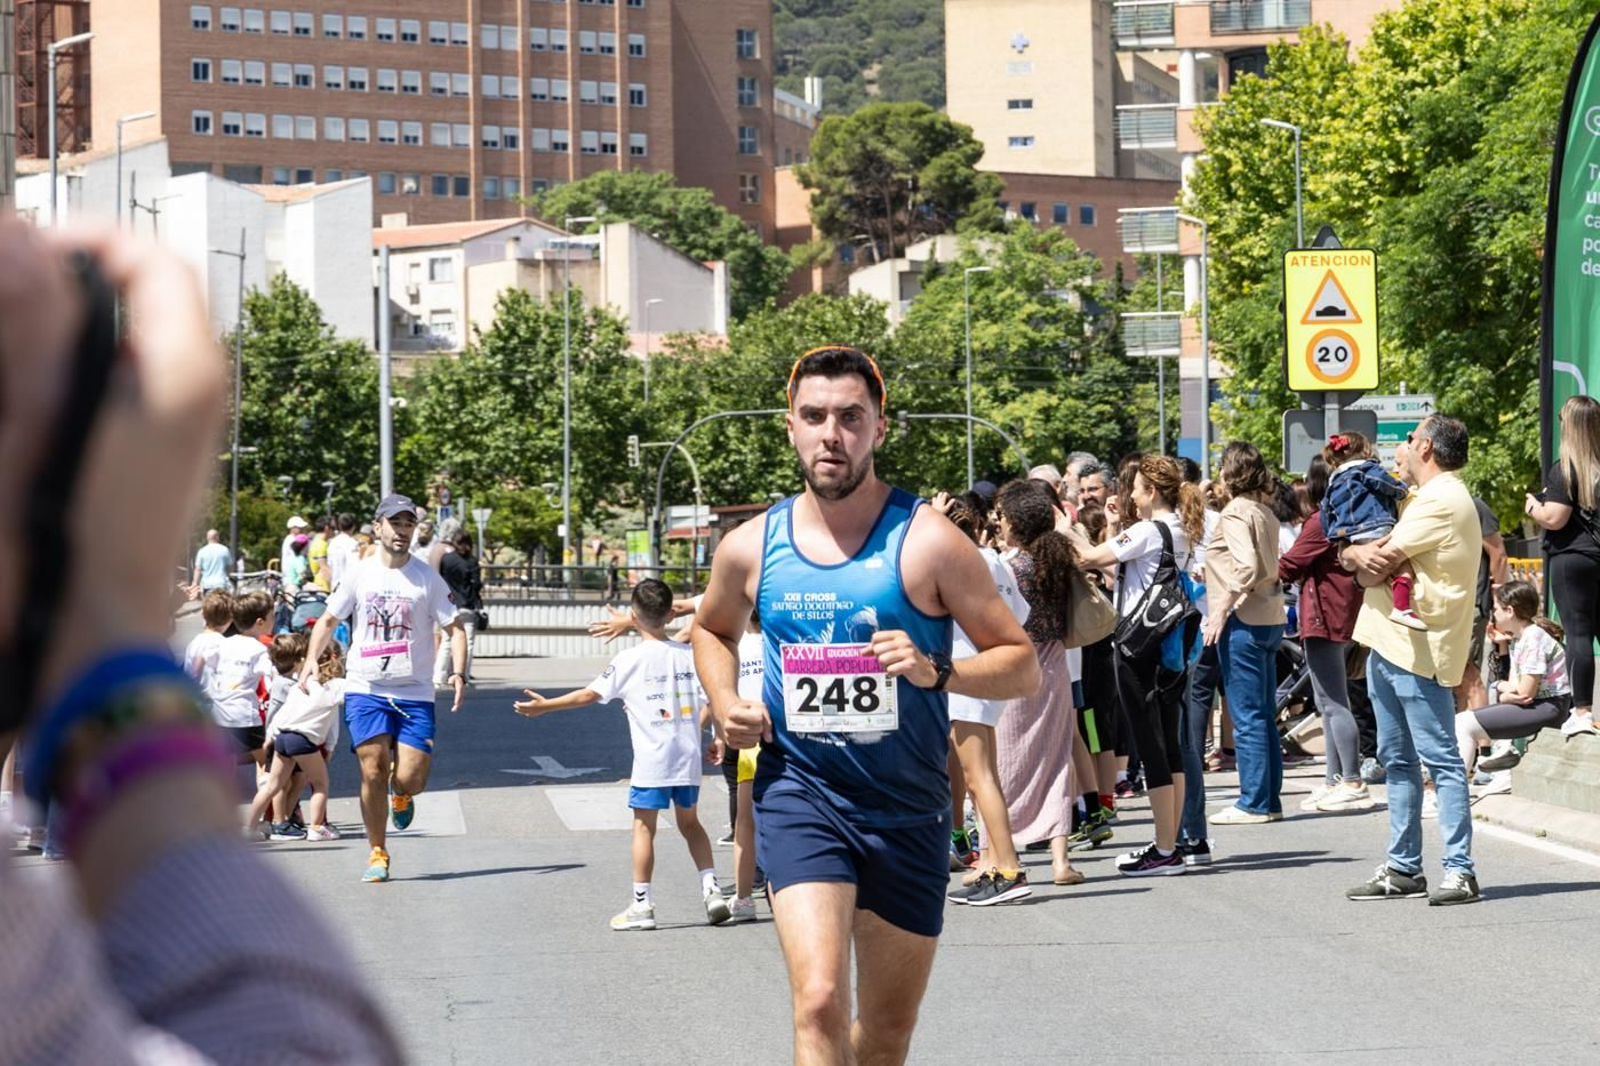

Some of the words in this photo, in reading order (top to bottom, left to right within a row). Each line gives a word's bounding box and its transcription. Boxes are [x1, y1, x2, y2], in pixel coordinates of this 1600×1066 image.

[1588, 162, 1600, 180] T
[1290, 255, 1371, 266] ATENCION
[1318, 346, 1348, 362] 20
[804, 592, 836, 602] CROSS
[805, 602, 854, 611] DOMINGO
[793, 611, 805, 620] DE
[806, 611, 834, 620] SILOS
[786, 646, 824, 660] XXVII
[381, 656, 391, 671] 7
[787, 660, 833, 674] CARRERA
[796, 676, 880, 713] 248
